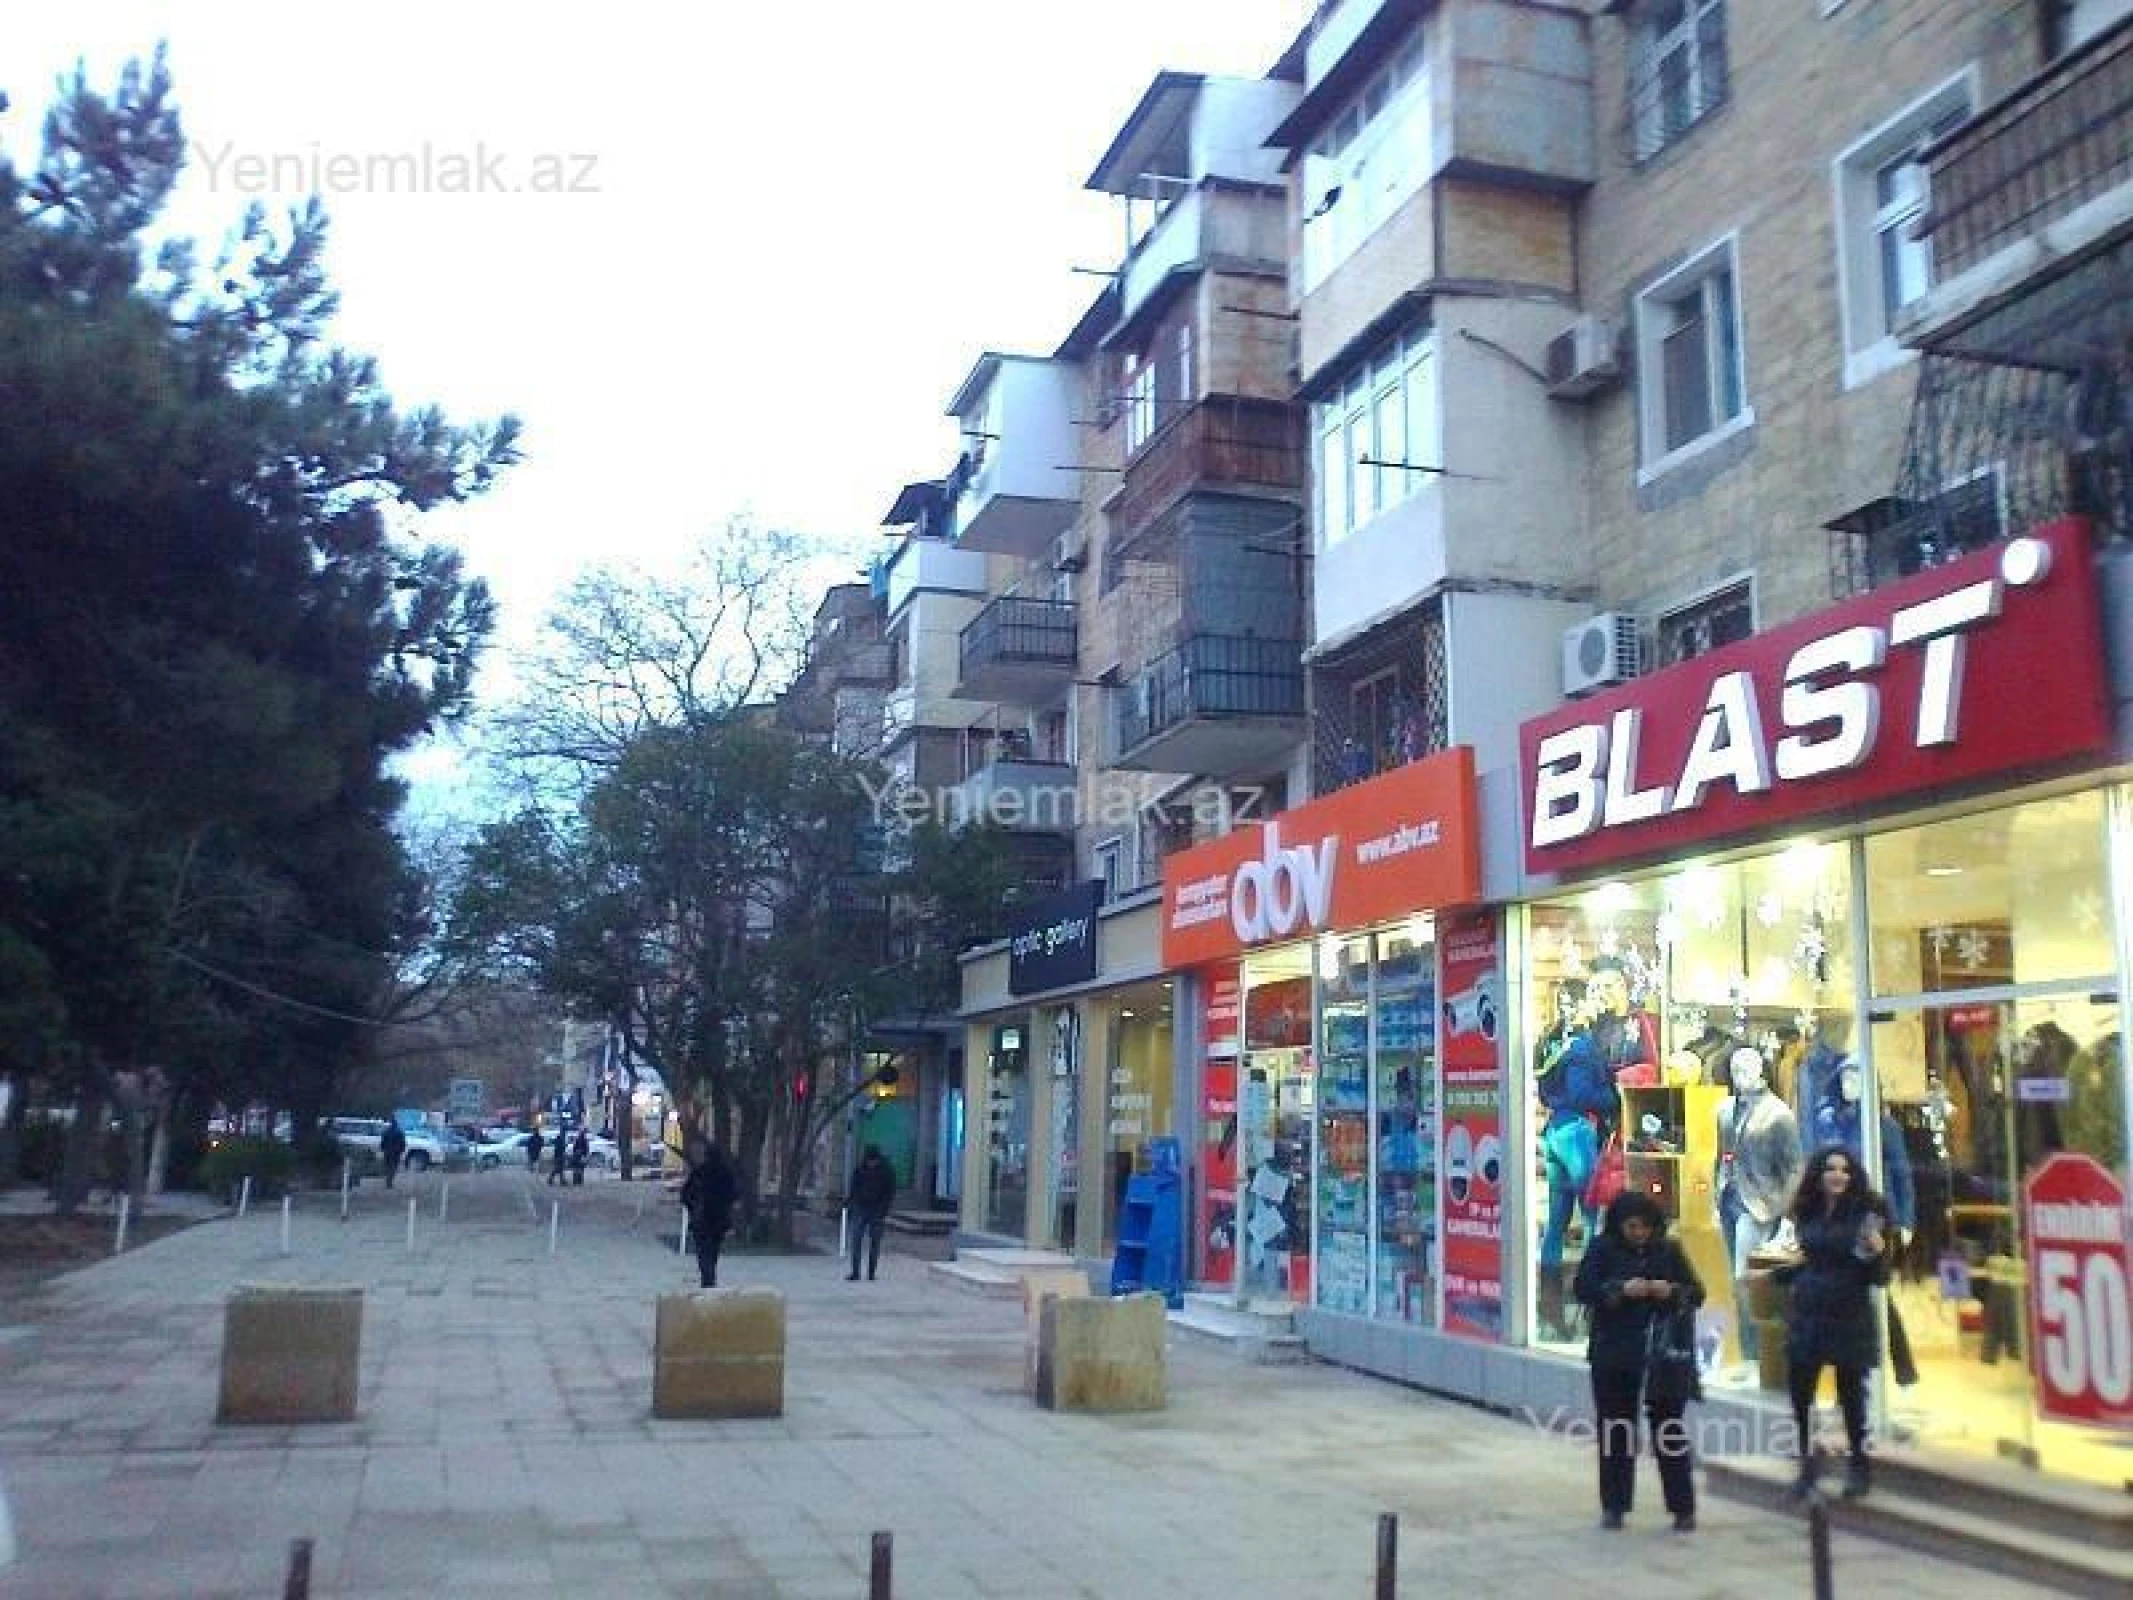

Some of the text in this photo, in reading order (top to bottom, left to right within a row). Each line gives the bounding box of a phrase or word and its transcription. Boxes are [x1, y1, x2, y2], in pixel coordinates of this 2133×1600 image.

[1532, 581, 2005, 848] BLAST
[1231, 821, 1340, 944] abv
[2040, 1250, 2132, 1404] 50
